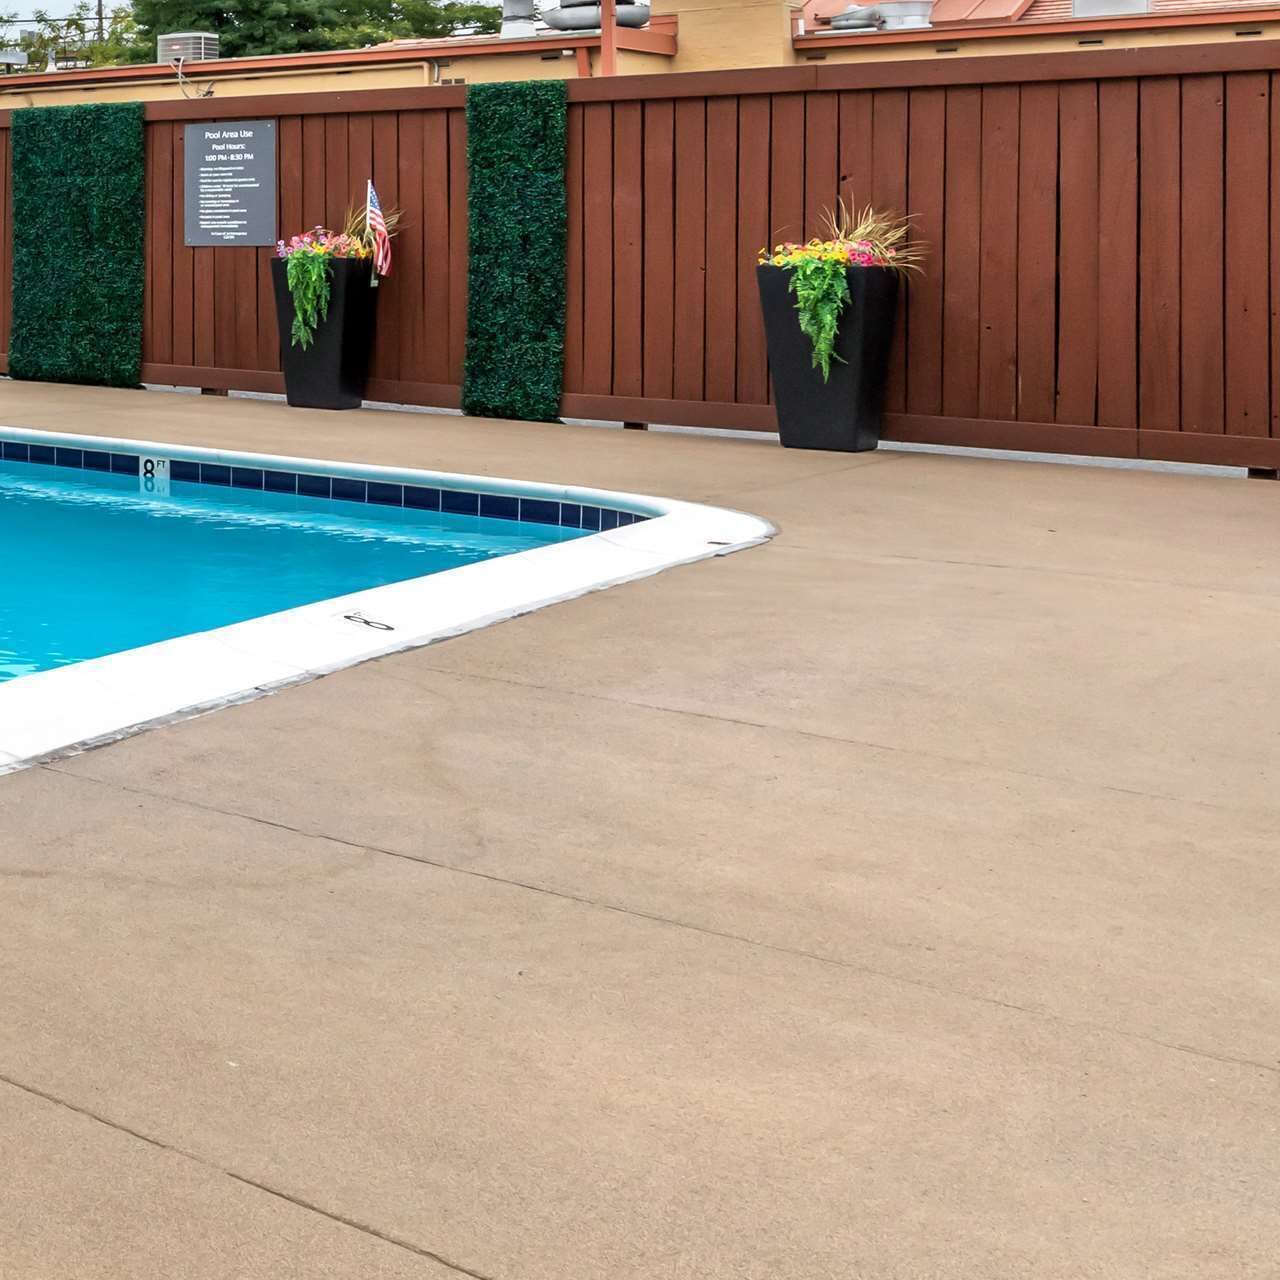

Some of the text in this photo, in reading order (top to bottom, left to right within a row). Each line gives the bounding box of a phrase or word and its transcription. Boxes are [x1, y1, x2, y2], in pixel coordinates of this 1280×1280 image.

[205, 130, 254, 139] Pool Area Use
[143, 458, 166, 478] 8 FT
